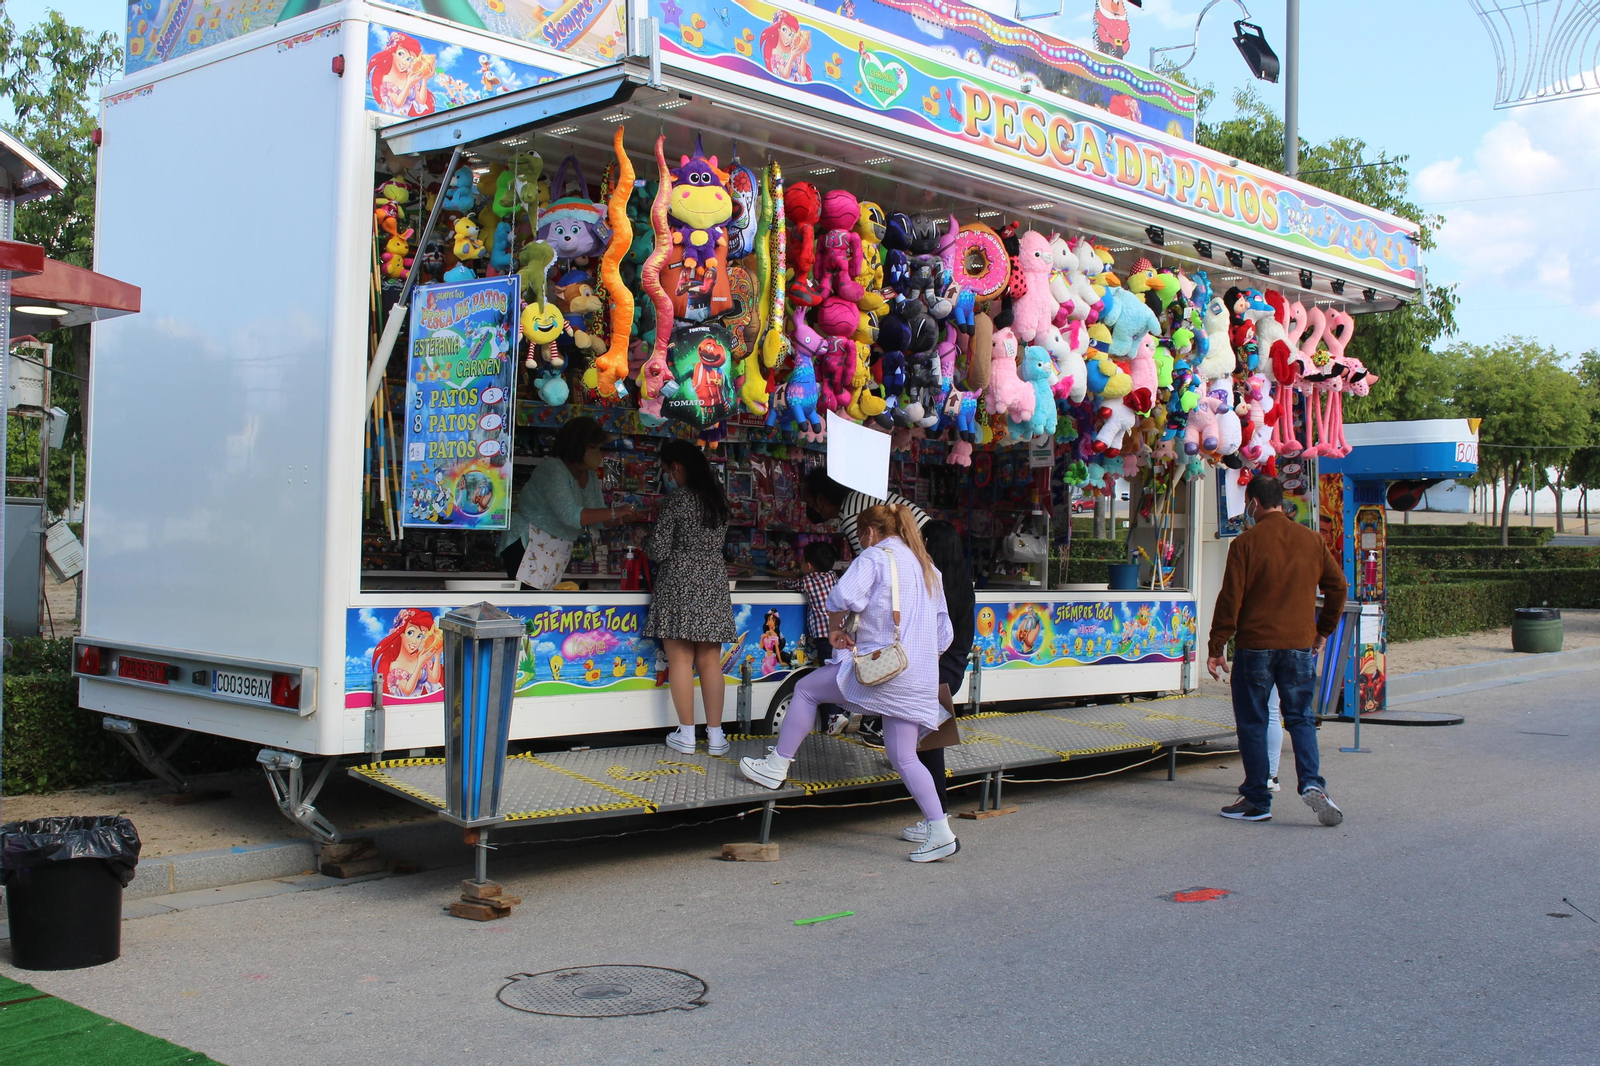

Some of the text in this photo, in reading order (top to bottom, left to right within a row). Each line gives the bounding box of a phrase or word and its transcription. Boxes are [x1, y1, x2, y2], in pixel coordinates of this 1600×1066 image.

[961, 84, 1279, 232] PESCA DE PATOS
[983, 281, 1002, 295] donut
[421, 289, 508, 329] PESCA DE PATOS
[413, 335, 460, 358] ESTEFANIA
[456, 358, 501, 378] CARMEN
[415, 391, 424, 410] 3
[430, 388, 478, 408] PATOS
[488, 390, 495, 400] 3
[668, 399, 705, 407] TOMATO
[413, 414, 423, 433] 8
[428, 413, 477, 433] PATOS
[486, 416, 492, 427] 6
[428, 440, 477, 459] PATOS
[1288, 464, 1294, 473] 6
[1353, 486, 1385, 503] BOXING
[570, 634, 606, 655] love
